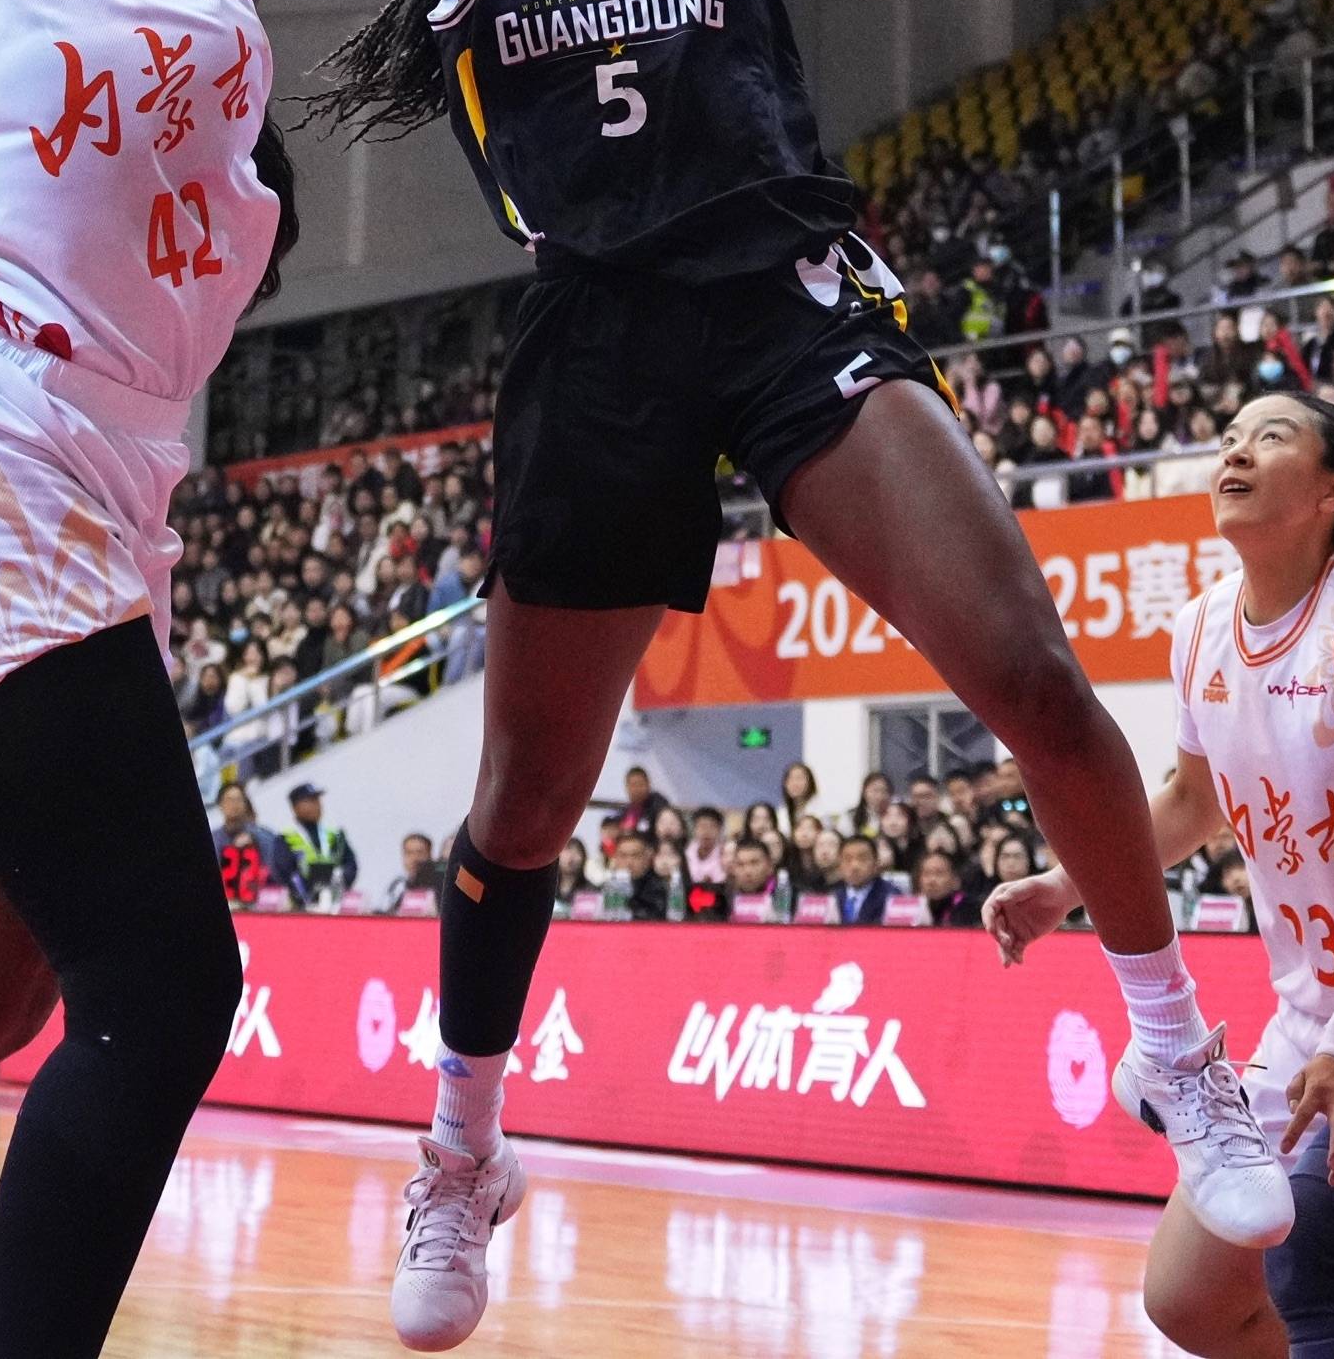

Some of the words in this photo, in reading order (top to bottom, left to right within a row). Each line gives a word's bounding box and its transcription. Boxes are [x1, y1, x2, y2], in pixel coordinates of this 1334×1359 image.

[595, 59, 648, 138] 5
[146, 181, 223, 289] 42
[667, 961, 928, 1108] 以体育人
